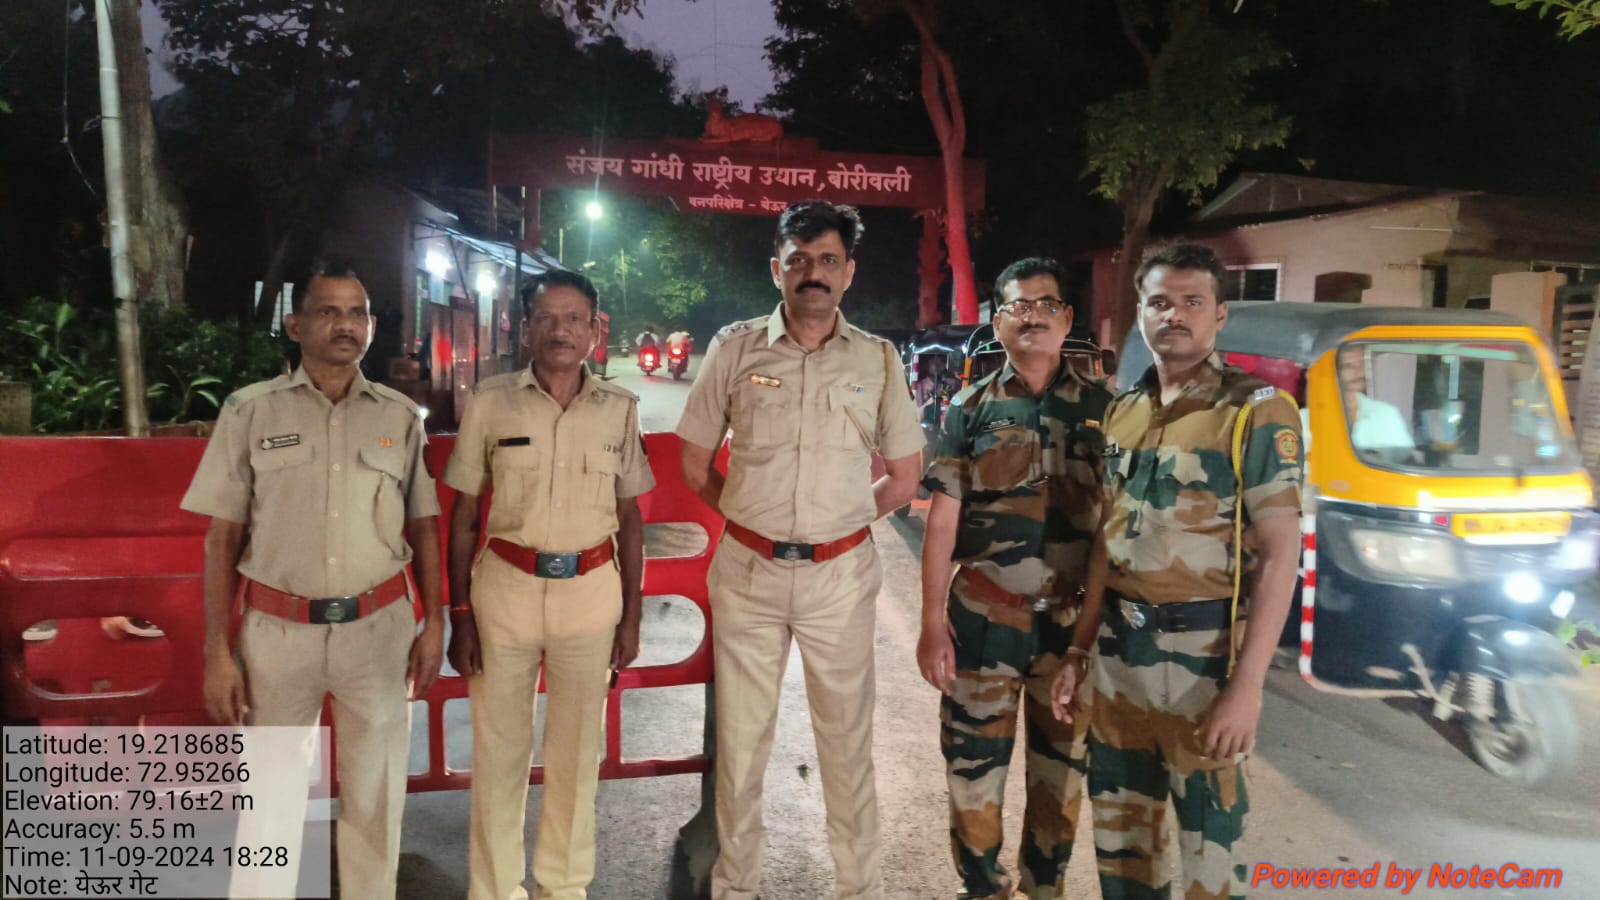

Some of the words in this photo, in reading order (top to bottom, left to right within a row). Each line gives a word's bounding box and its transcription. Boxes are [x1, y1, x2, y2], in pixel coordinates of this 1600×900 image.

[565, 148, 625, 178] संजय
[631, 152, 685, 181] गांधी
[692, 156, 753, 190] राष्ट्रीय
